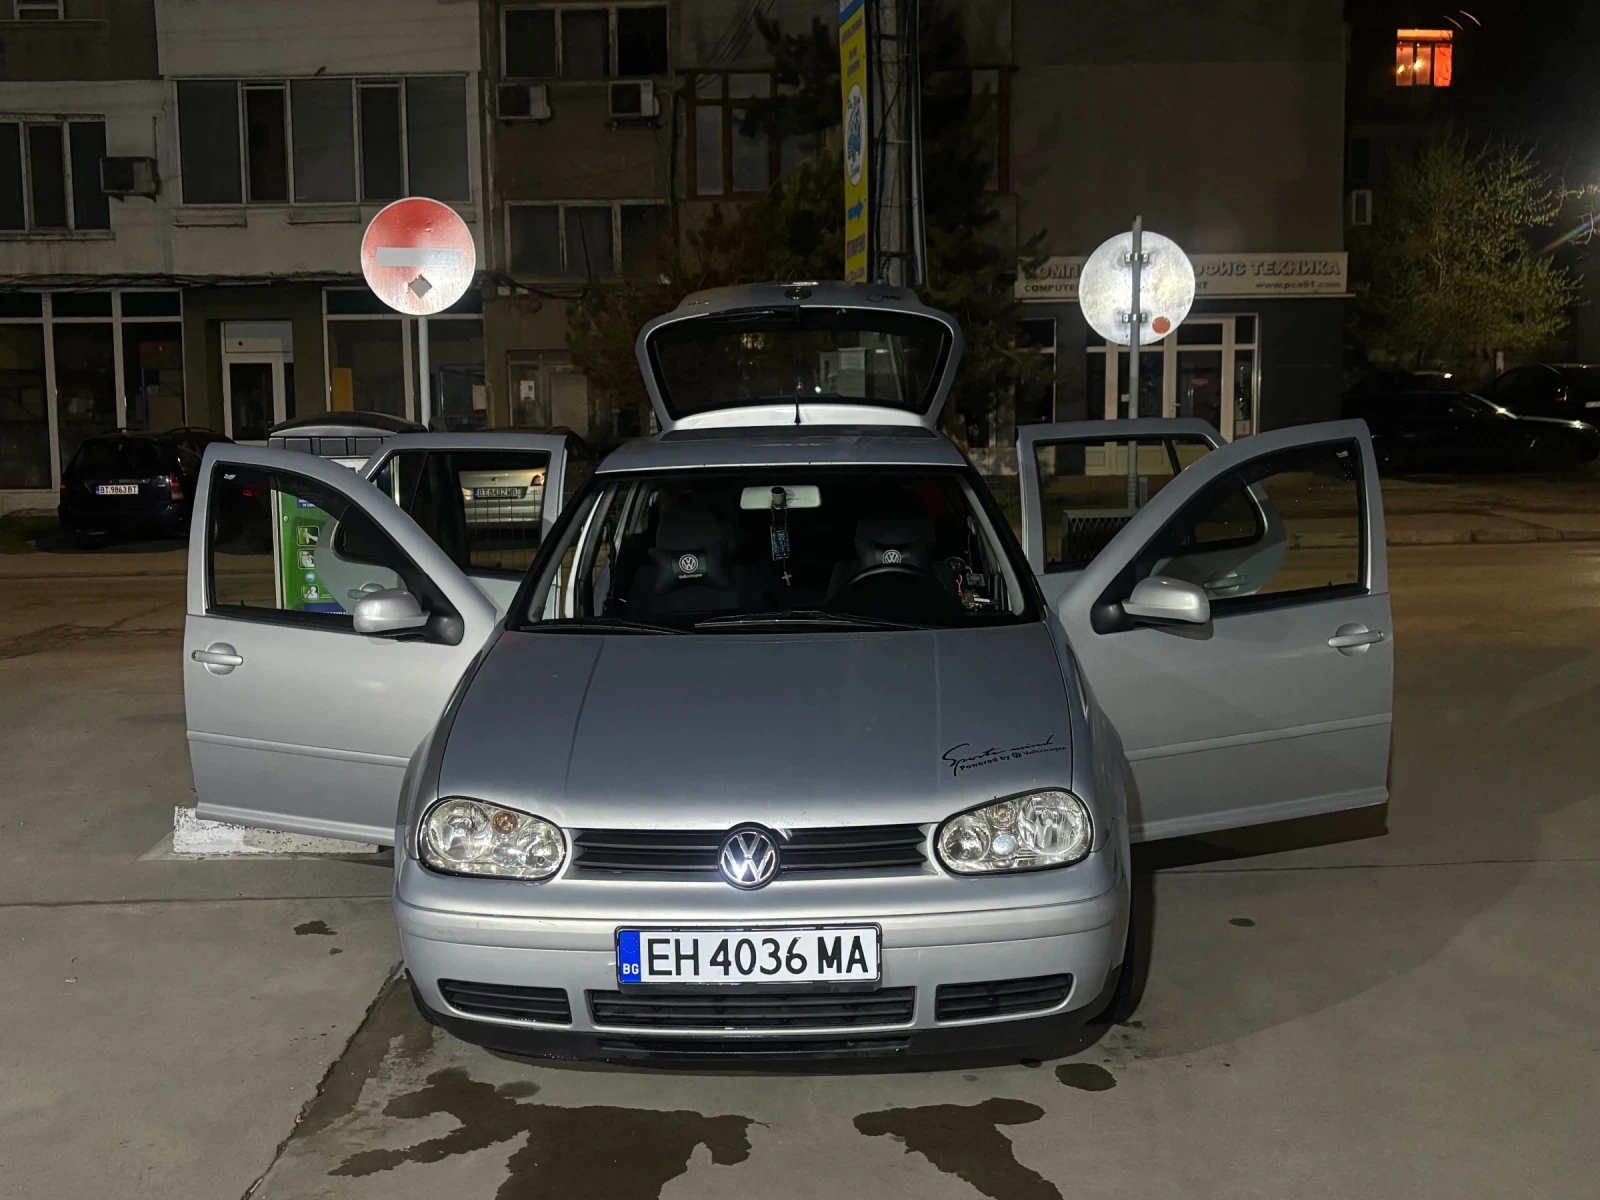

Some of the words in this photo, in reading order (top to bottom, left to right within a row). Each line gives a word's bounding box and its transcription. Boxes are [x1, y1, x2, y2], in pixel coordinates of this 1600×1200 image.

[1251, 260, 1341, 277] ТЕХНИКА
[1024, 284, 1078, 292] COMPUTE
[959, 757, 999, 771] Powered
[999, 754, 1010, 762] by
[1023, 746, 1067, 756] Volkswagen
[622, 963, 639, 975] BG
[647, 937, 699, 976] EH
[709, 936, 808, 976] 4036
[817, 935, 869, 974] MA
